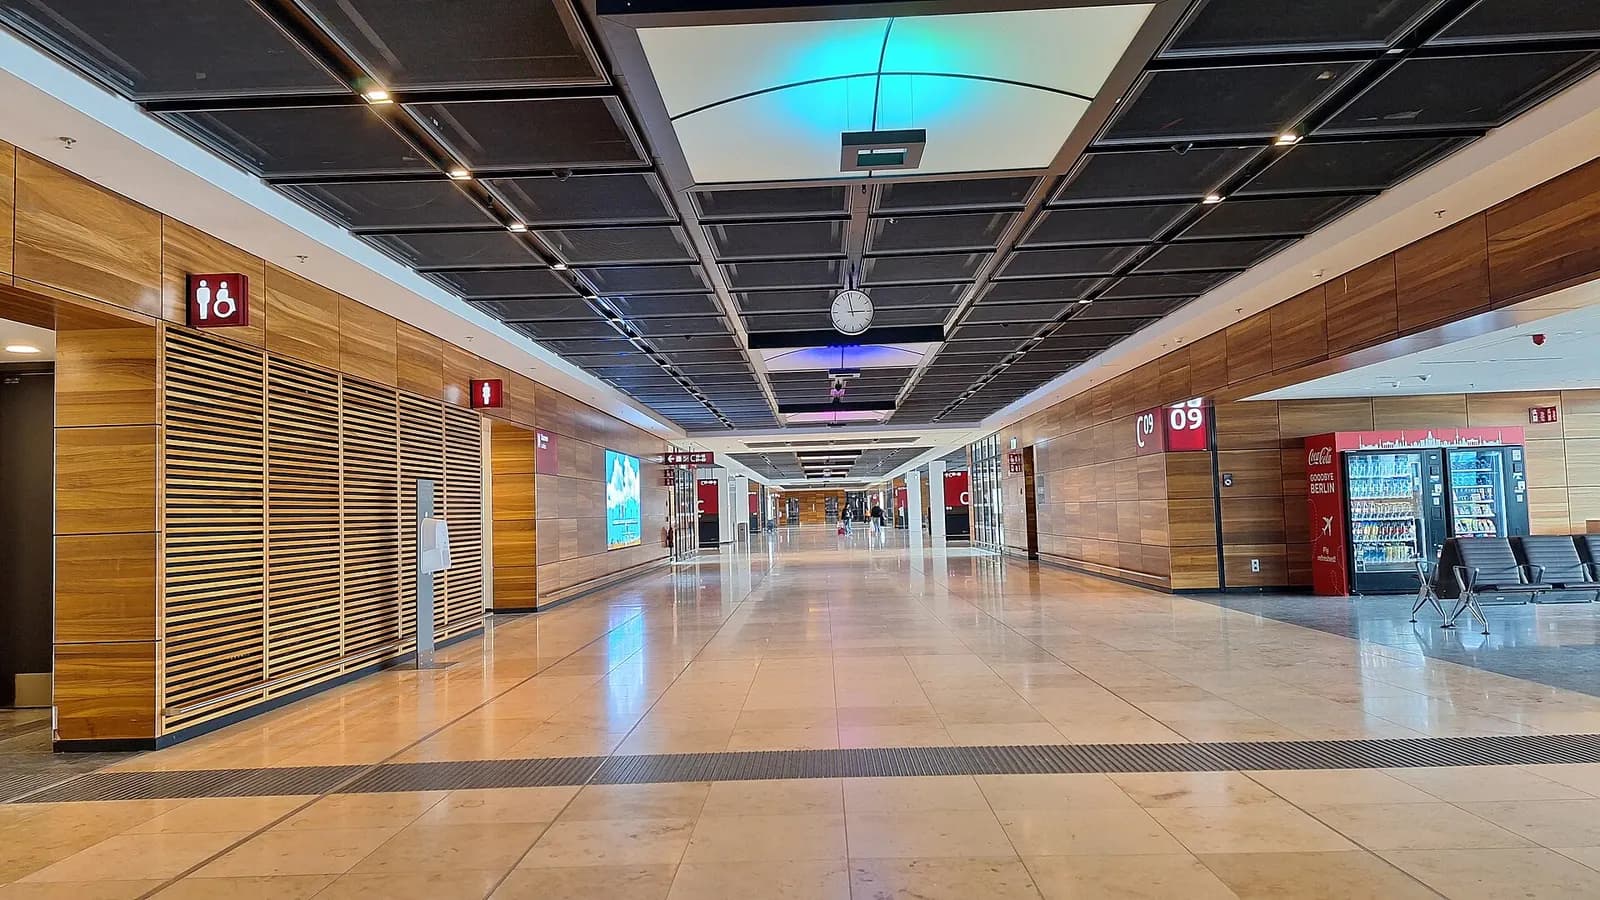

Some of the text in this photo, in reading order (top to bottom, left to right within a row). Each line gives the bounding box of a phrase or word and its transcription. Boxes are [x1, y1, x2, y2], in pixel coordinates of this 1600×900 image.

[1170, 409, 1203, 430] 09
[1309, 472, 1334, 482] GOODBYE
[1310, 482, 1335, 494] BERLIN
